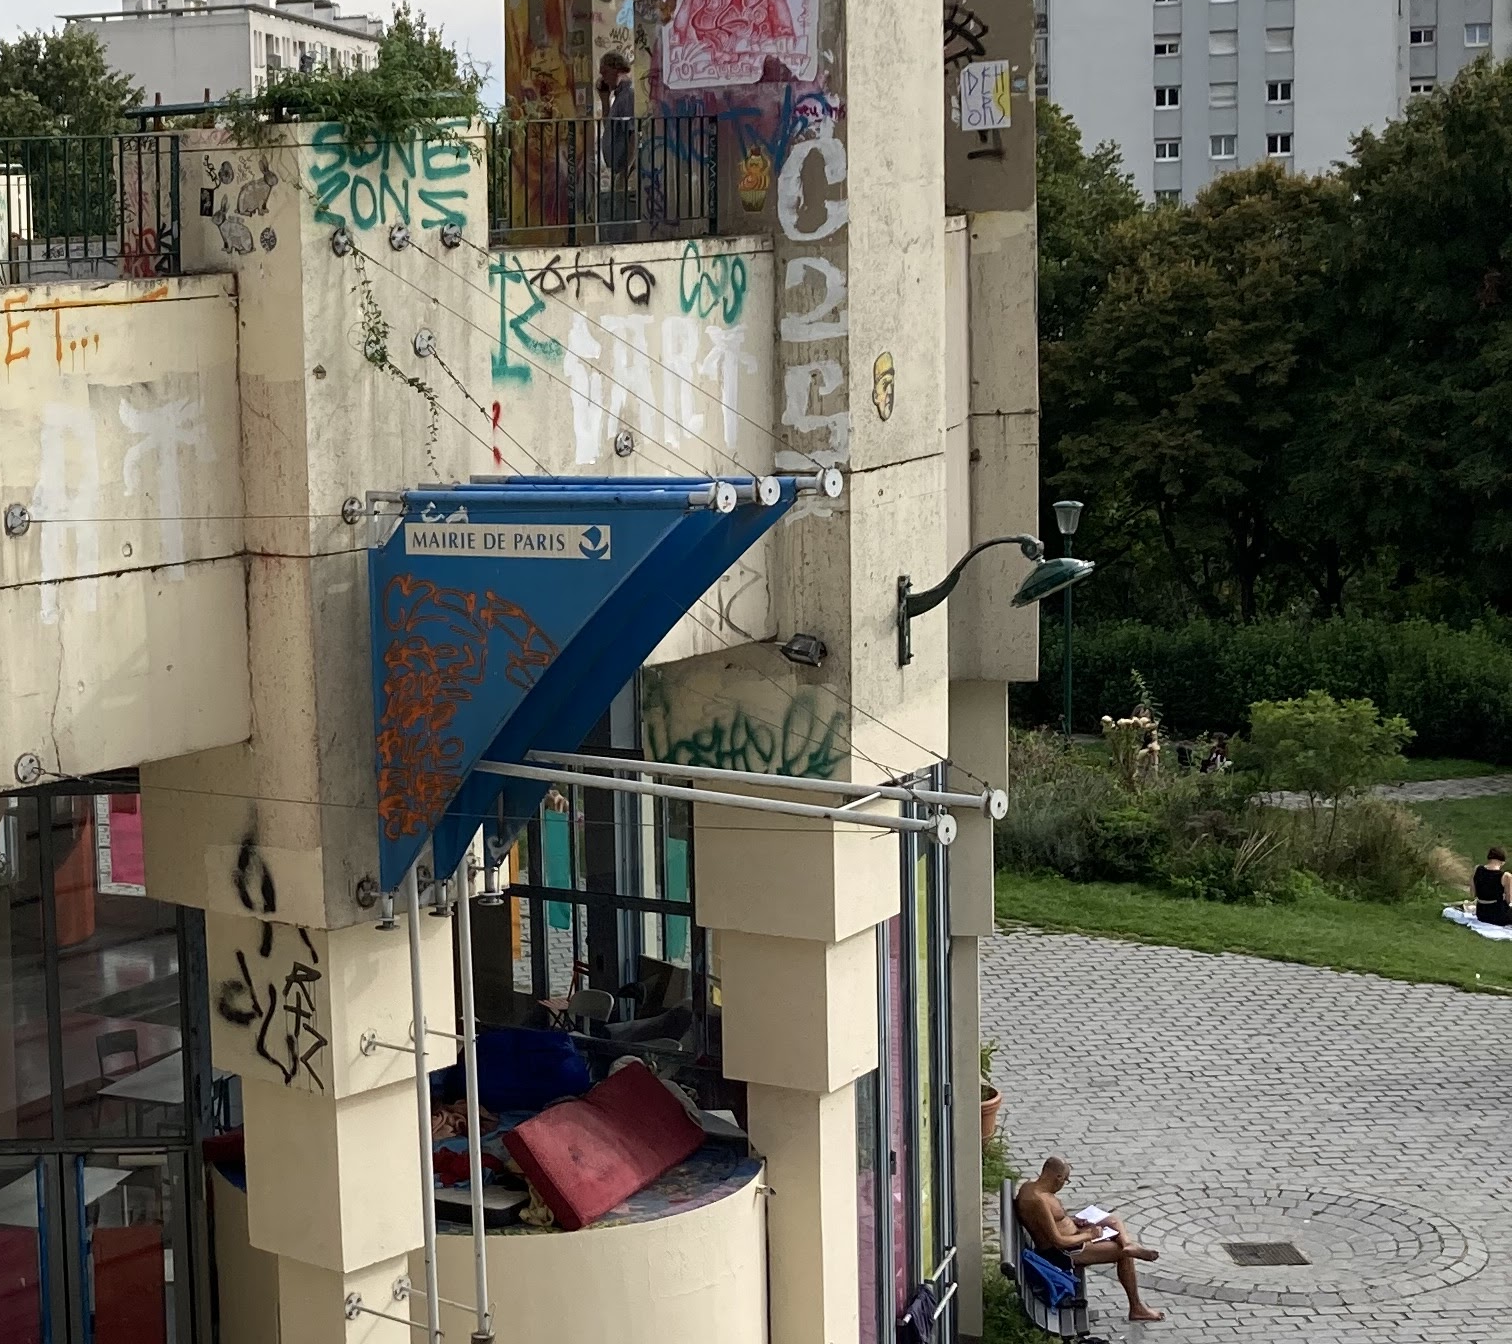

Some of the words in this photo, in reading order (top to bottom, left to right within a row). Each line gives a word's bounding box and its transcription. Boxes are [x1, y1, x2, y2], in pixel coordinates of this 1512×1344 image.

[412, 531, 476, 551] MAIRIE
[483, 533, 507, 551] DE
[513, 533, 566, 552] PARIS
